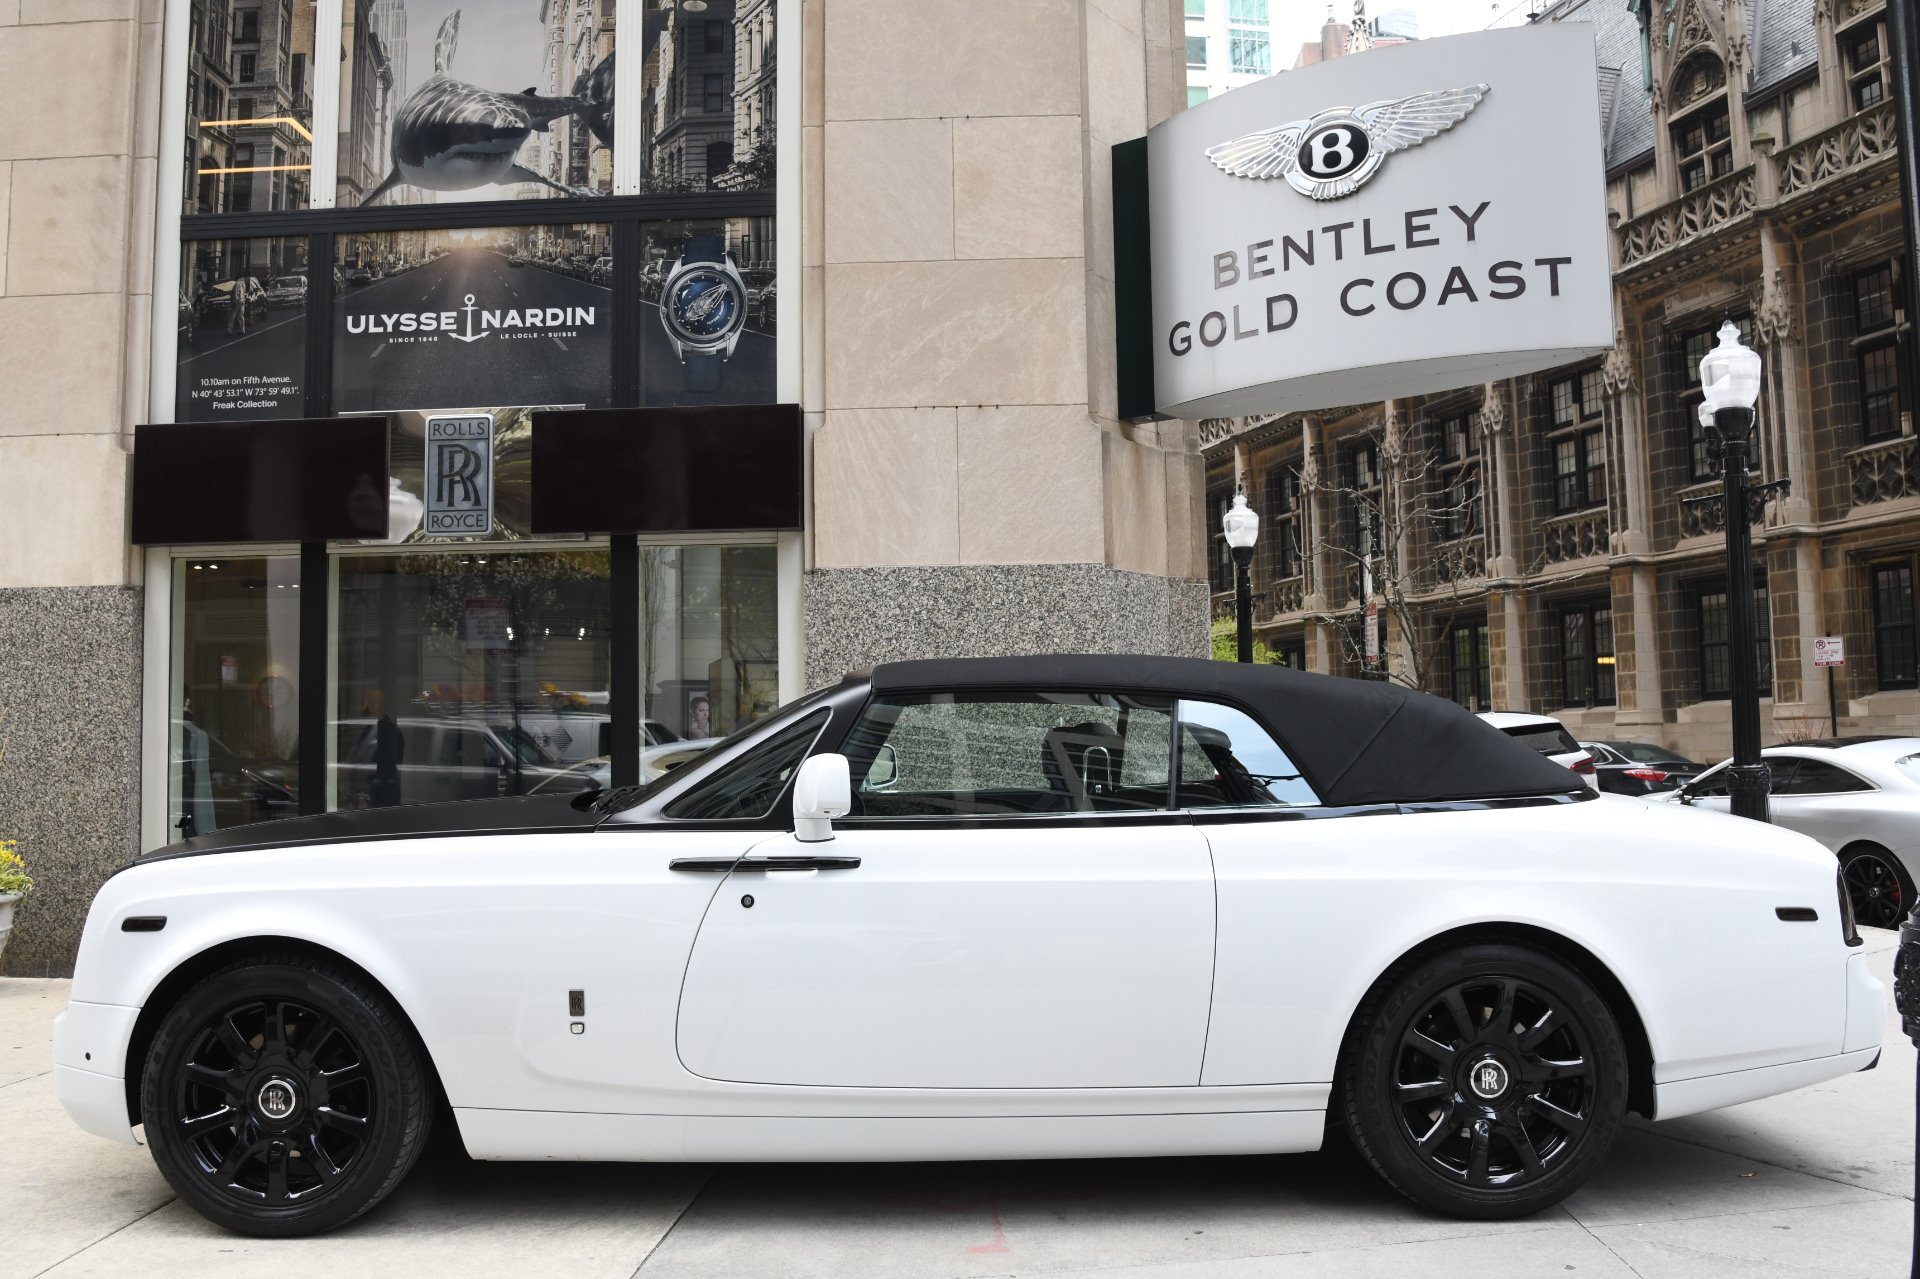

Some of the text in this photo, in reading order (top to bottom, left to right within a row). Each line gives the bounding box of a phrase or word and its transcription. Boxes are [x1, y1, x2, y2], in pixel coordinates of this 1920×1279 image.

[1213, 201, 1491, 290] BENTLEY
[1168, 256, 1572, 357] GOLD COAST
[346, 306, 595, 334] ULYSSE NARDIN
[200, 378, 230, 386] 10.10am
[243, 376, 260, 384] Fifth
[262, 376, 292, 384] Avenue.
[200, 390, 212, 398] 40°
[255, 388, 266, 396] 73°
[213, 400, 277, 409] Freak Collection
[432, 422, 485, 436] ROLLS
[436, 444, 482, 508] RR
[432, 514, 484, 528] ROYCE
